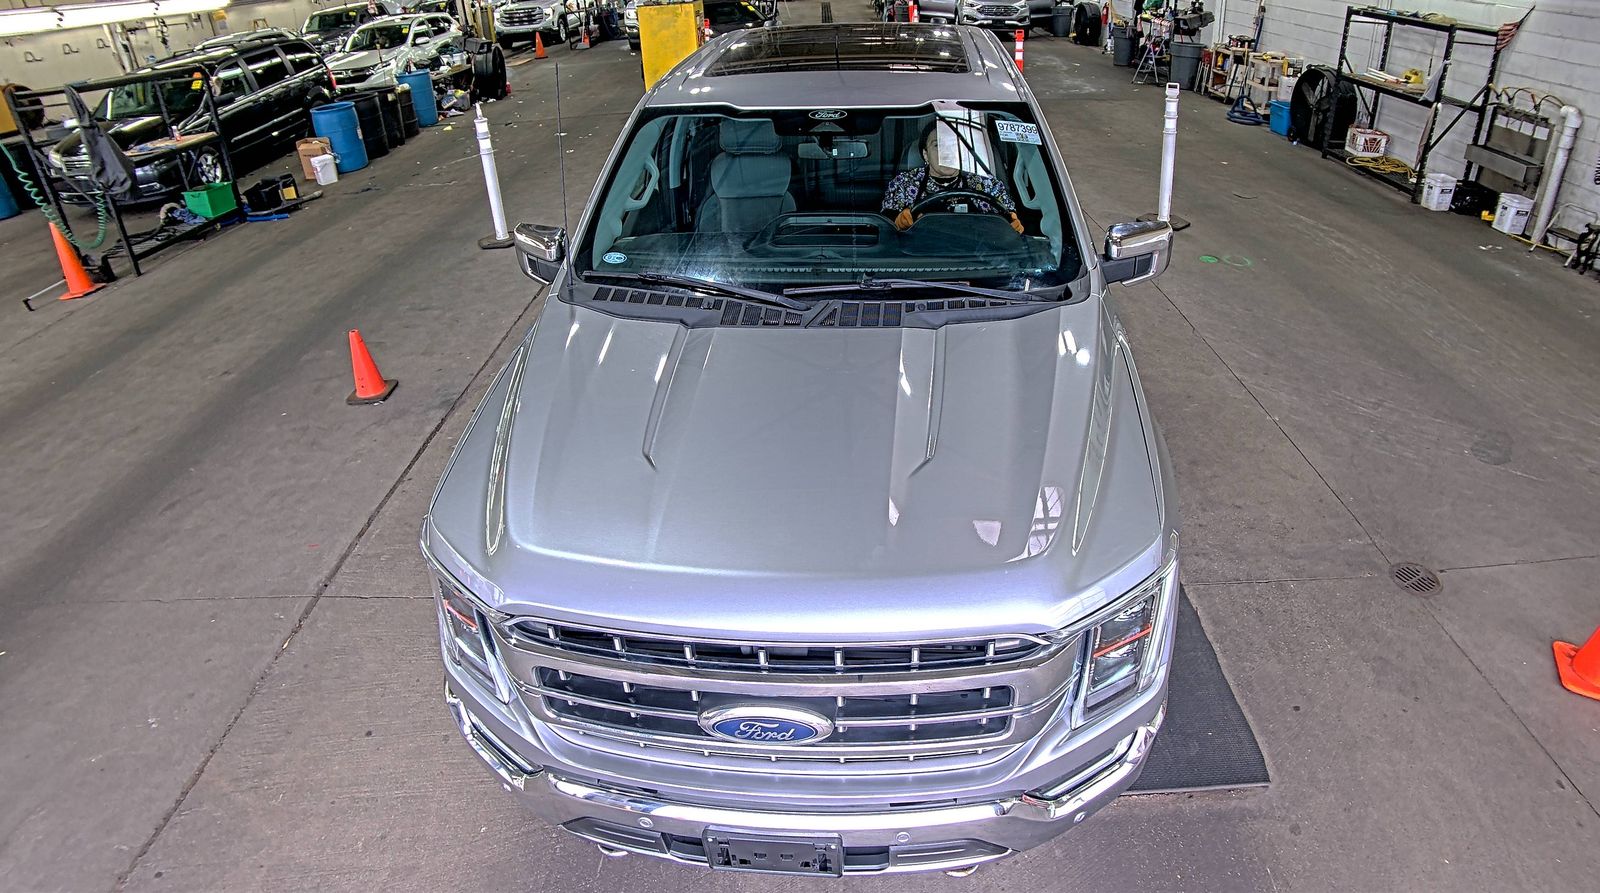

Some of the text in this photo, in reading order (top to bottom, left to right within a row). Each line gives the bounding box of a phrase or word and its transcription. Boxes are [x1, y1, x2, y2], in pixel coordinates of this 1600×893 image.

[815, 110, 841, 118] Ford
[997, 122, 1038, 135] 9787399
[734, 721, 796, 741] Ford
